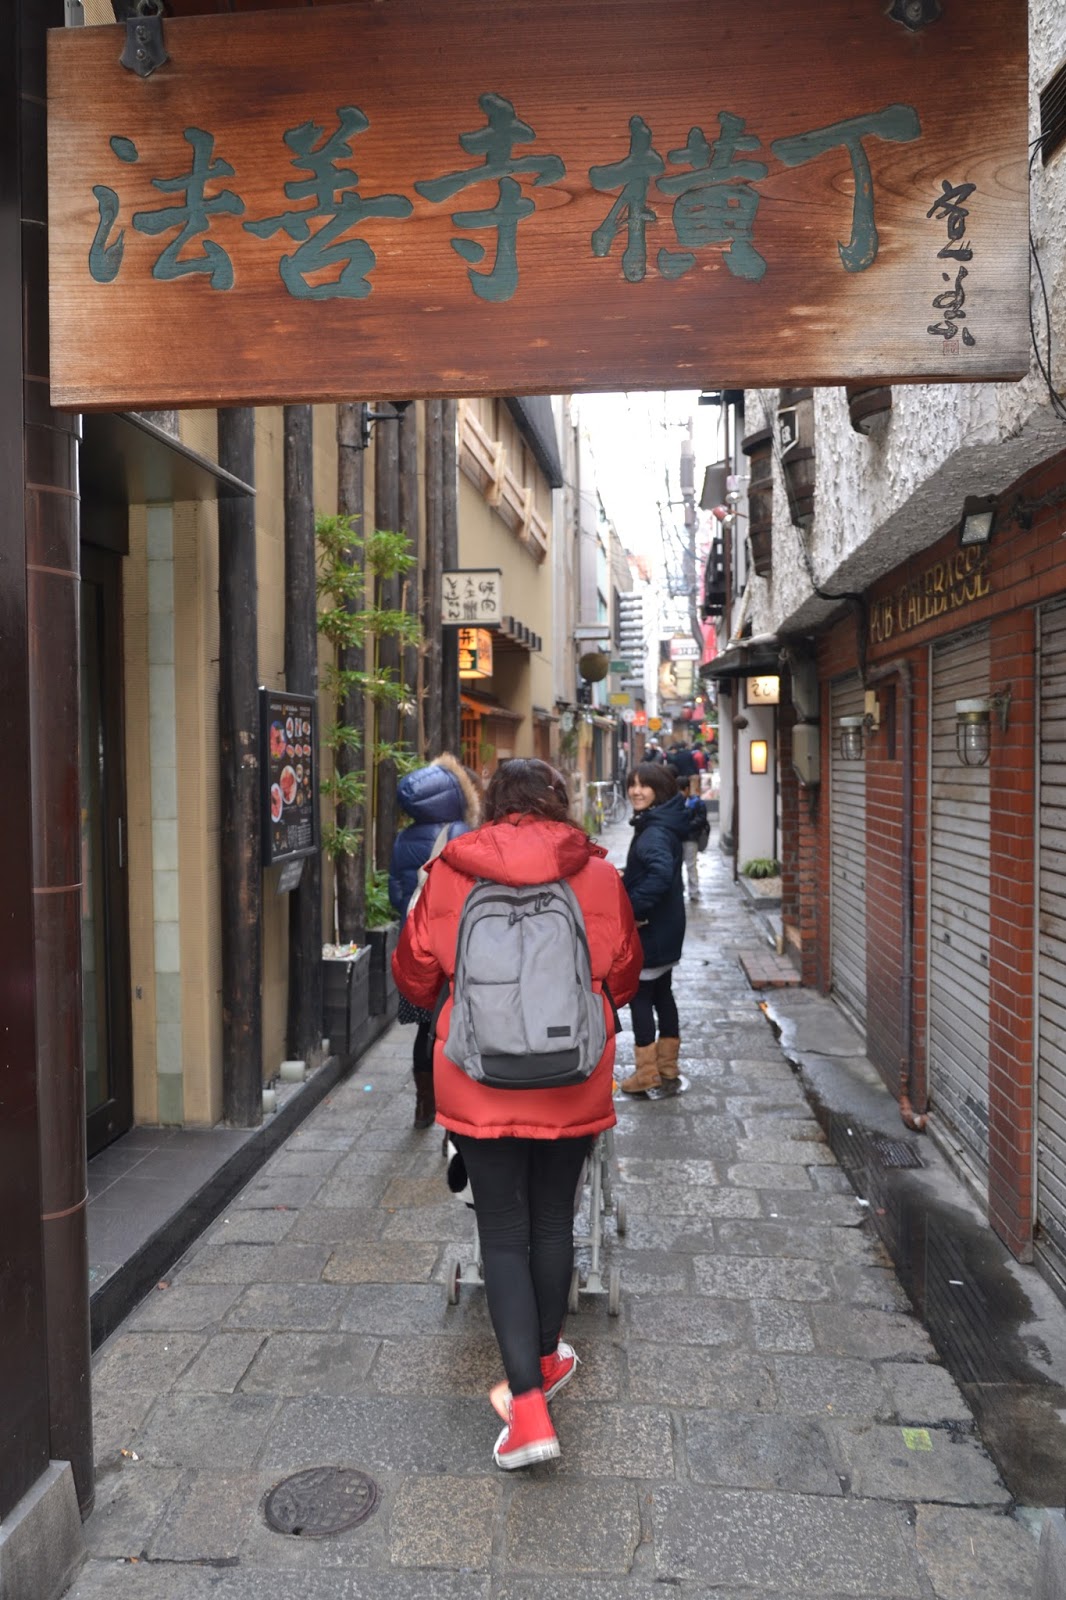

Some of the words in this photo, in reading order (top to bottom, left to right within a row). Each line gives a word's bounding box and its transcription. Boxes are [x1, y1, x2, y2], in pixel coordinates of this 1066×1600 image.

[87, 92, 922, 303] 法善寺横丁
